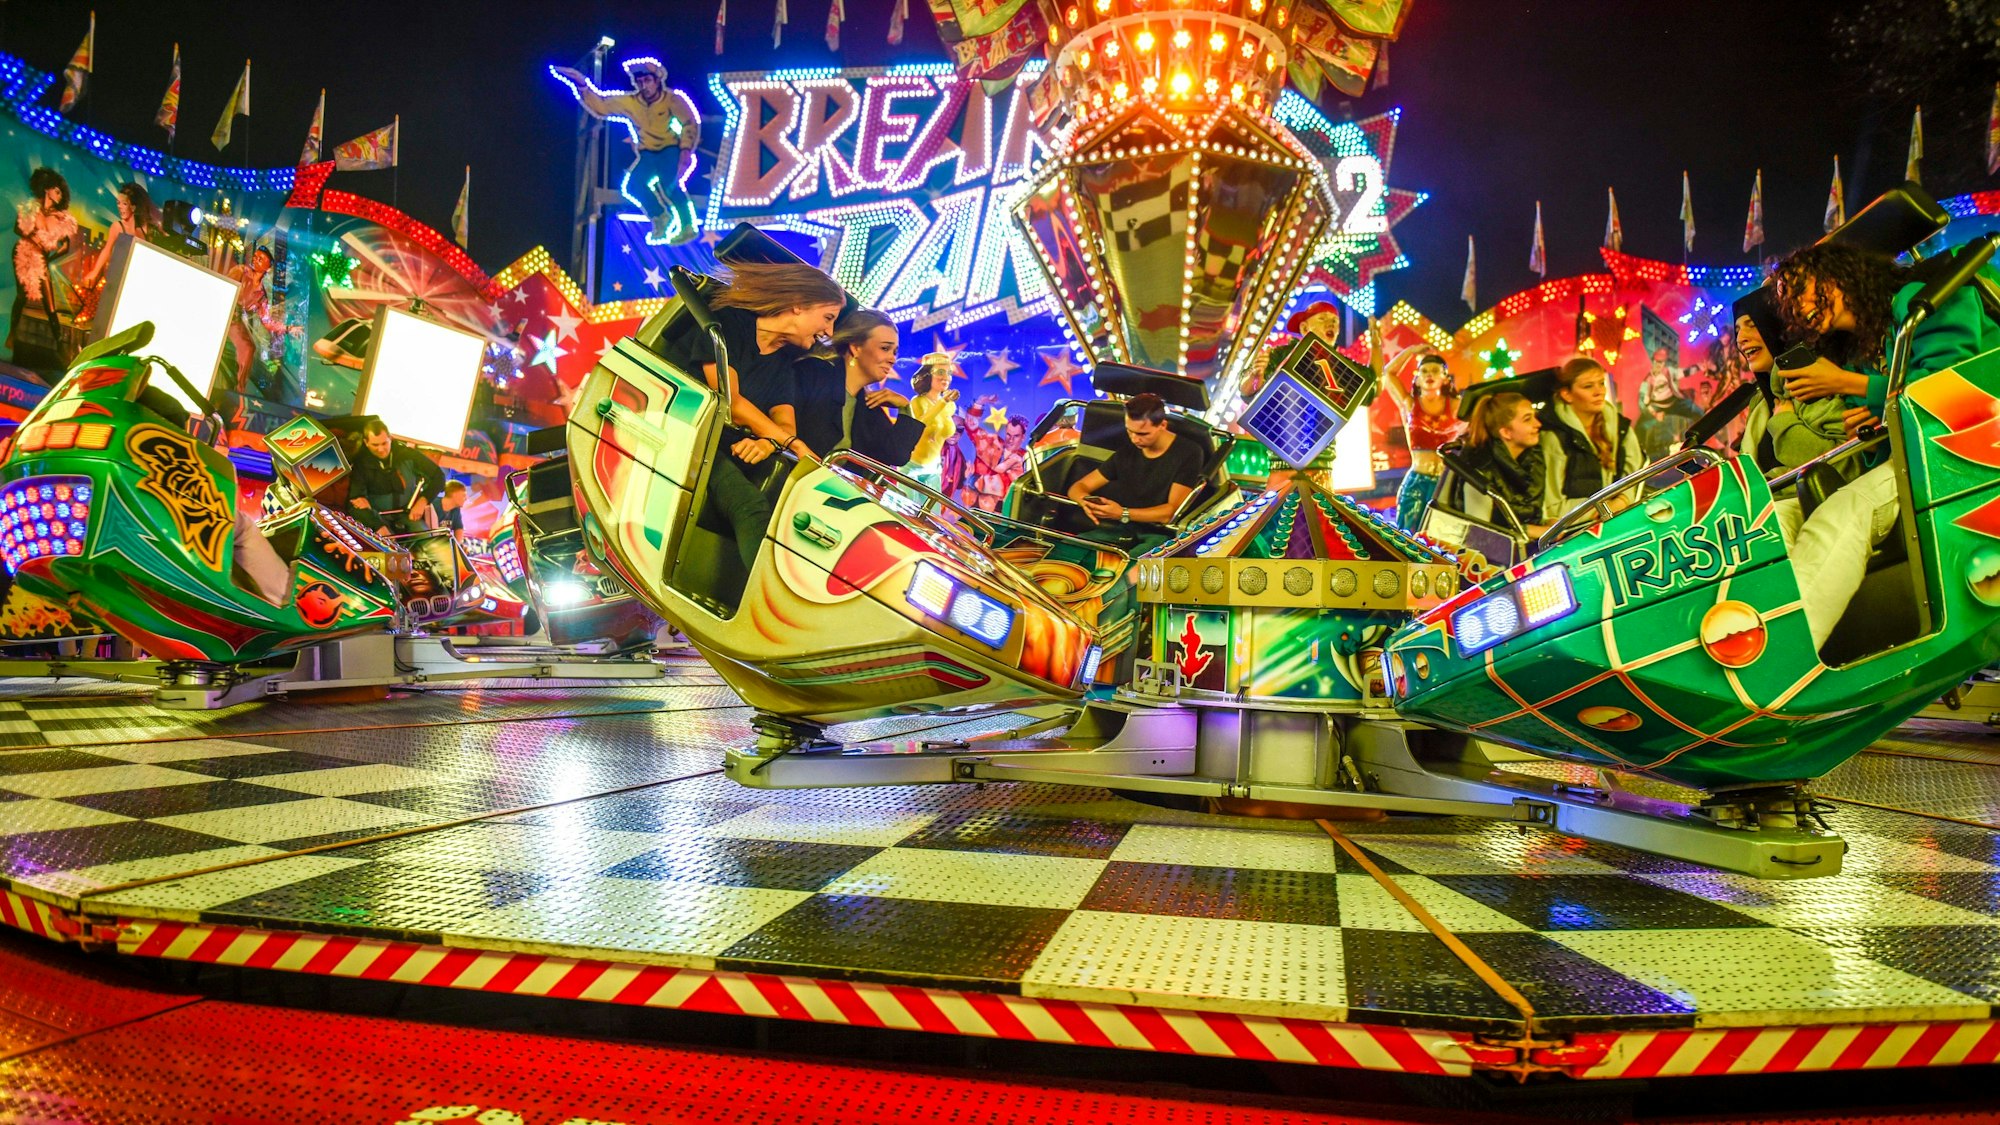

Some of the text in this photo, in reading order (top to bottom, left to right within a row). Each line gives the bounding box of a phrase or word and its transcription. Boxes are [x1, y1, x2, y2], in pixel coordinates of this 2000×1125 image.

[1335, 154, 1390, 234] 2
[1314, 358, 1345, 393] 1
[287, 427, 308, 448] 2
[1578, 511, 1769, 609] TRASH
